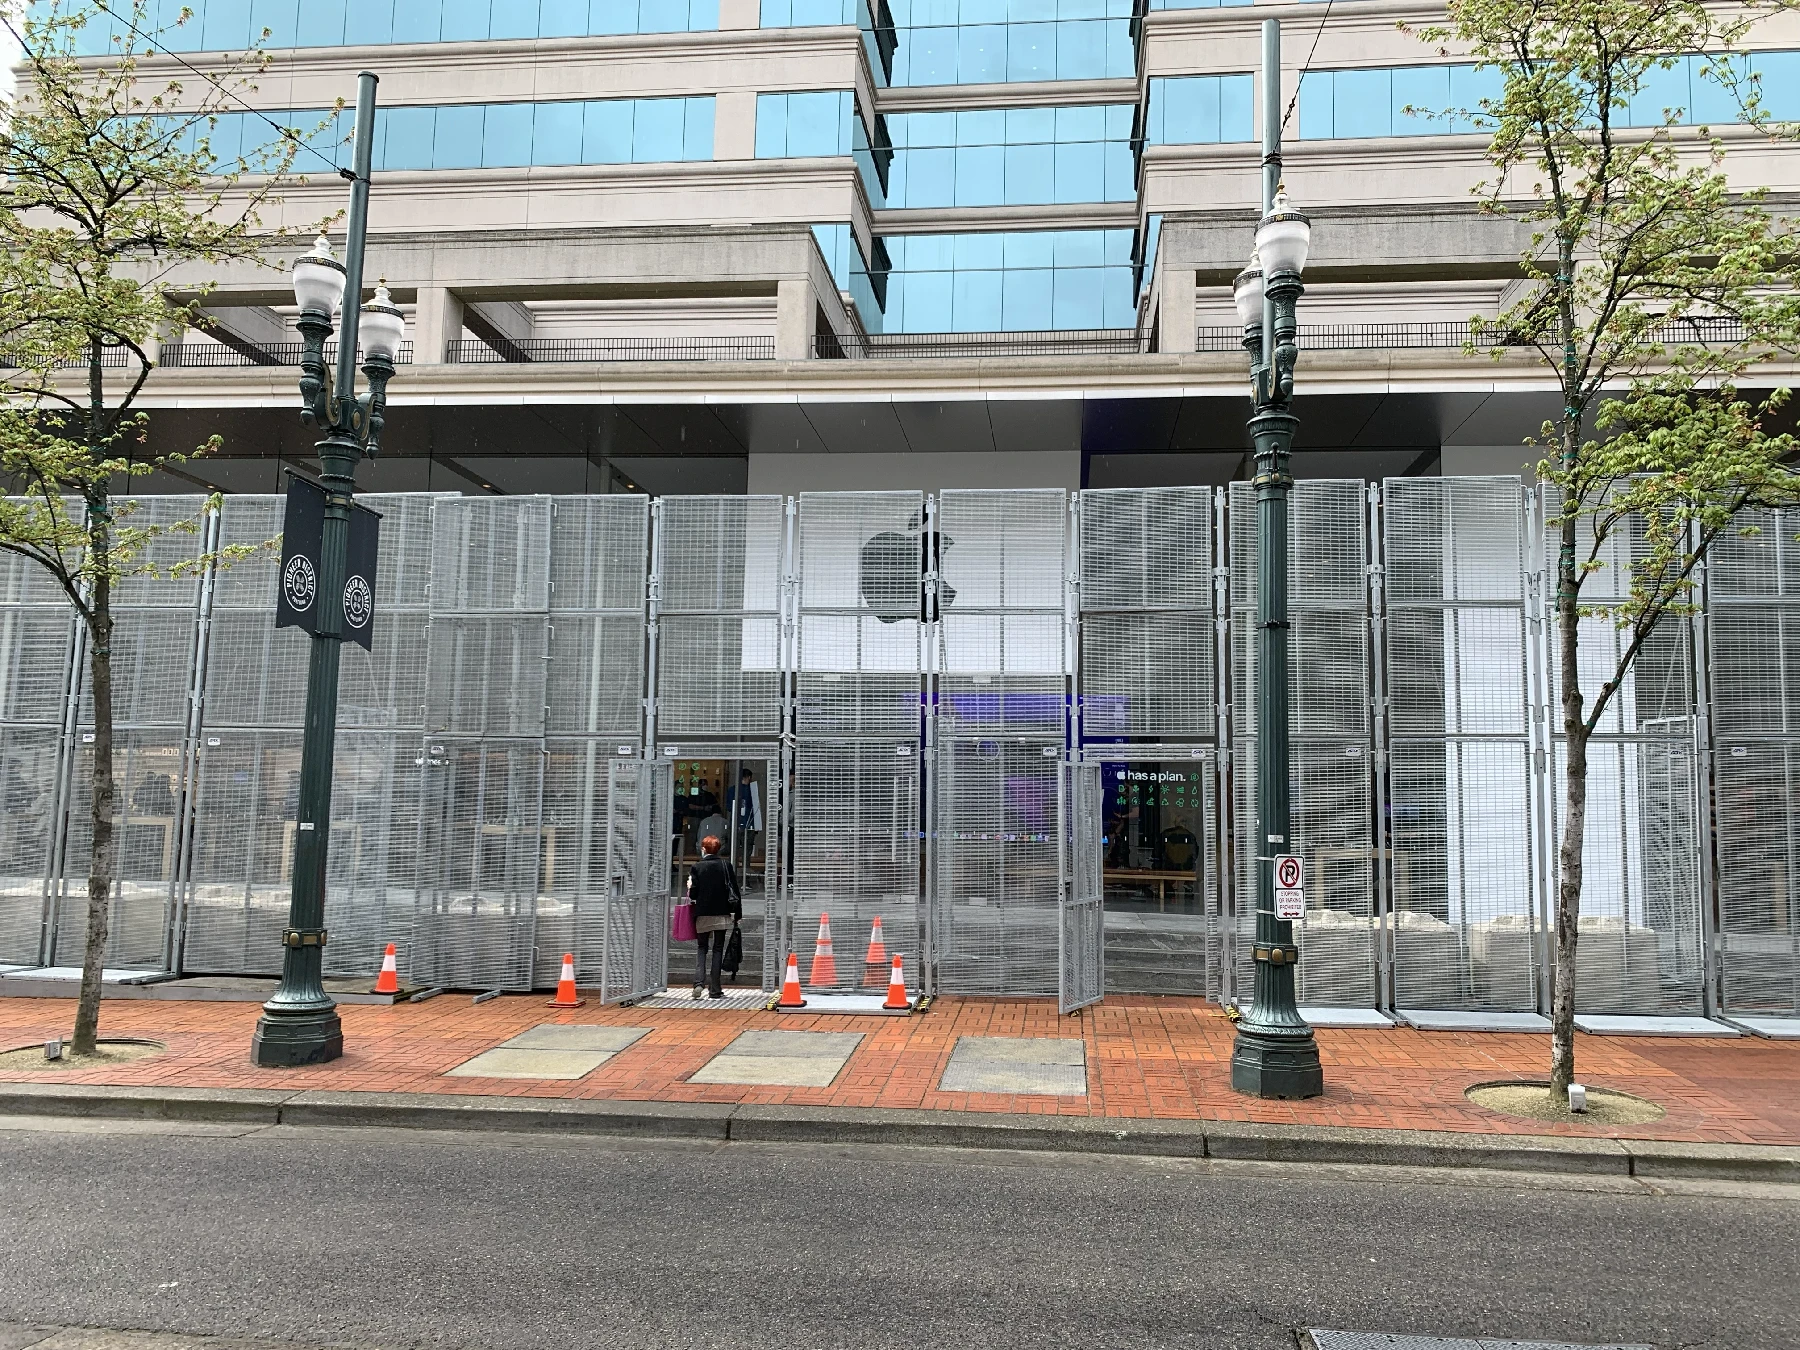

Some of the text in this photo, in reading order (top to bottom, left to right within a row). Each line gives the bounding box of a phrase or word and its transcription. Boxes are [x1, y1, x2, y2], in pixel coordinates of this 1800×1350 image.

[287, 558, 313, 595] PIONEER DISTRICT
[345, 579, 369, 613] PIONEER DISTRICT
[1127, 769, 1186, 784] has a plan.
